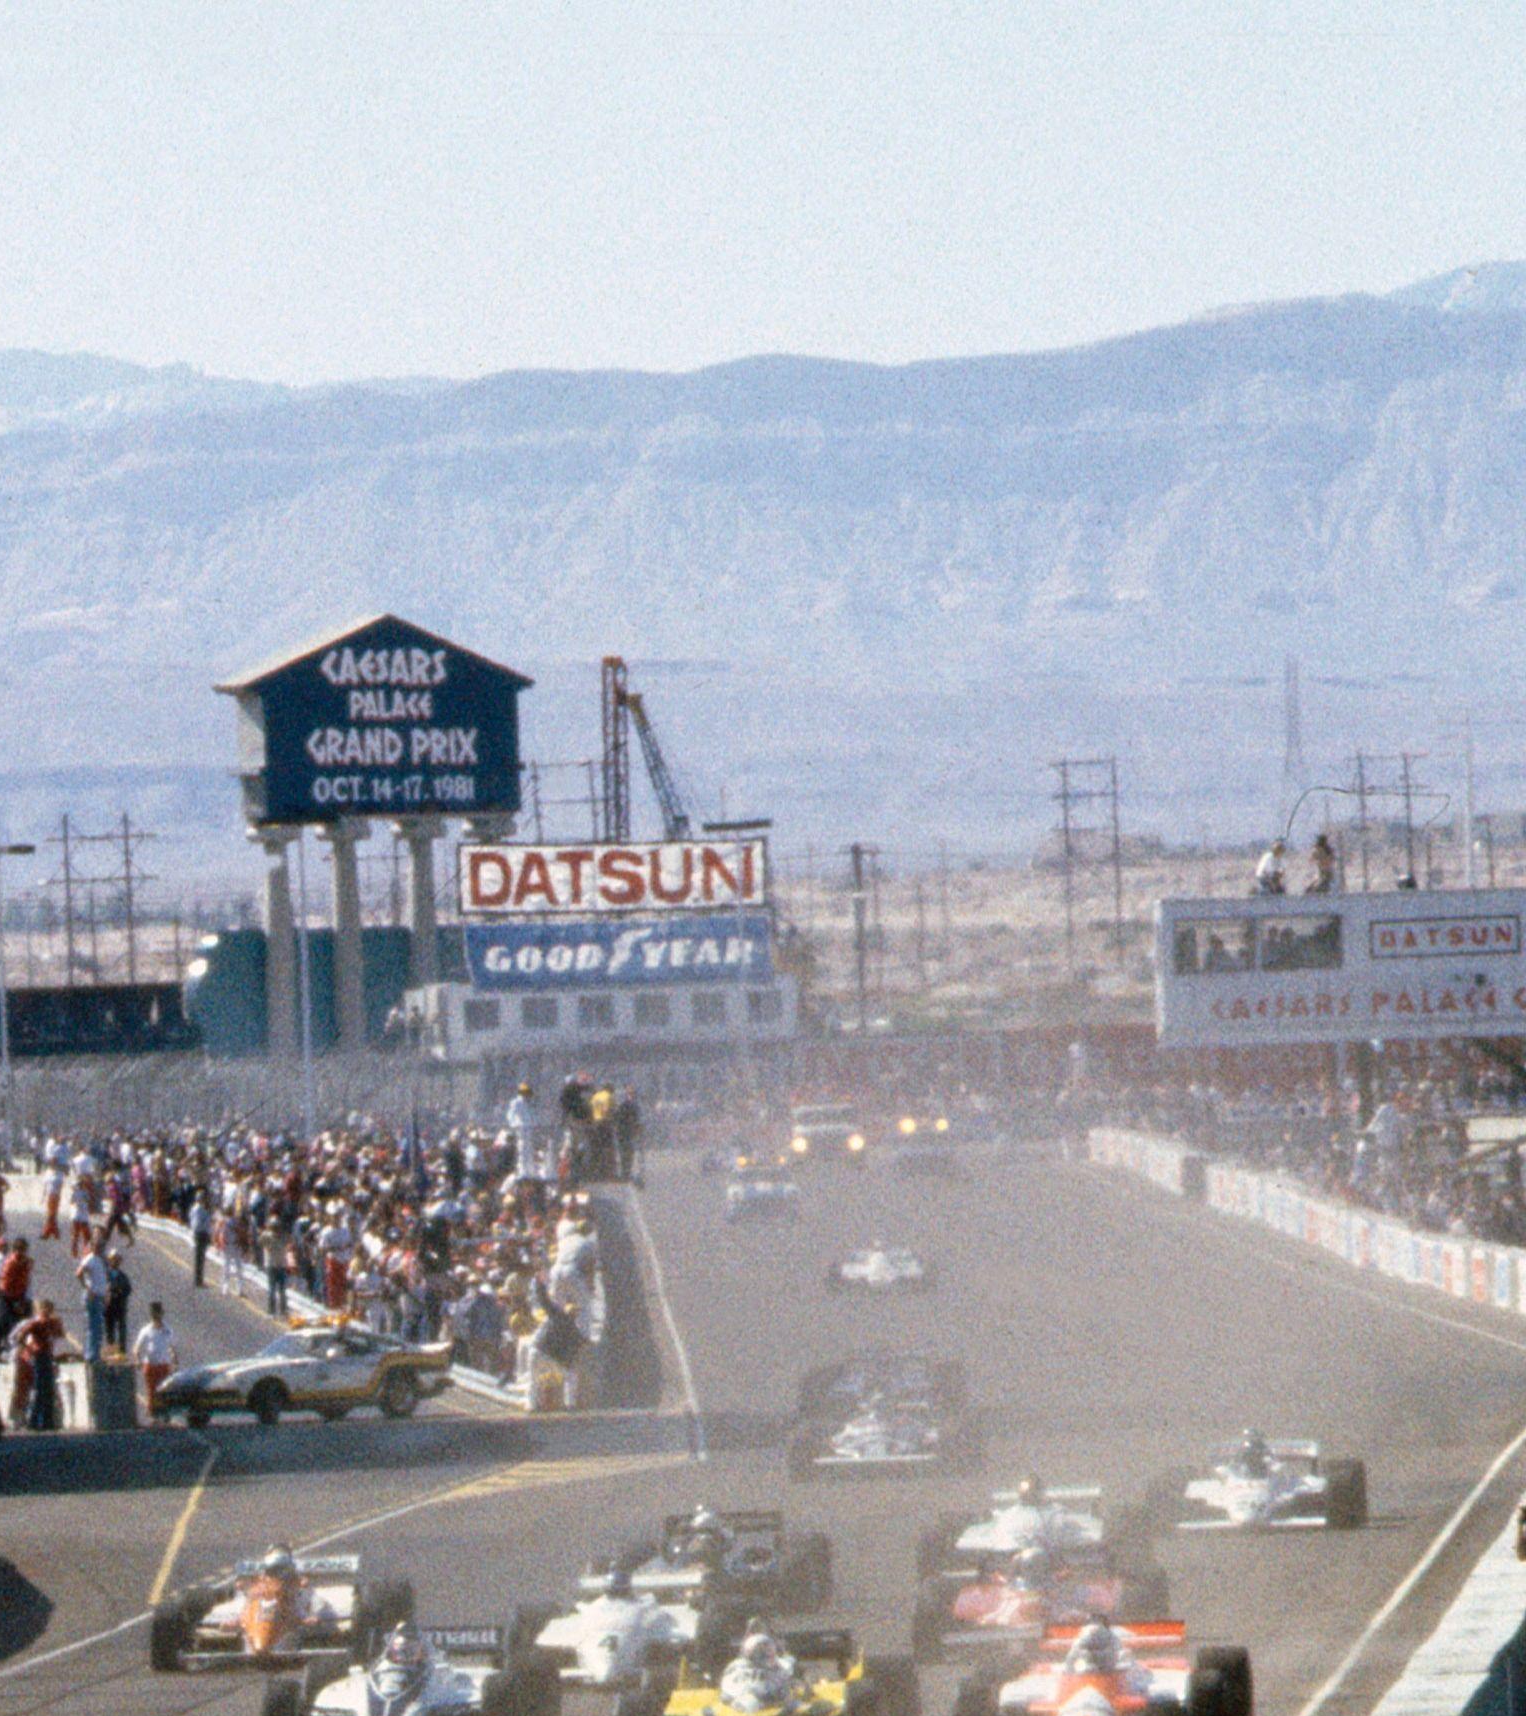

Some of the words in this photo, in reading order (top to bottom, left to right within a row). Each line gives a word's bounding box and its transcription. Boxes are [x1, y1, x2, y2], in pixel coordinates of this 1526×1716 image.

[319, 646, 447, 685] CAESARS
[349, 688, 432, 720] PALACE
[306, 727, 403, 766] GRAND
[411, 727, 479, 766] PRIX
[311, 775, 366, 802] OCT.
[433, 773, 476, 800] 1981
[468, 846, 754, 906] DATSUN
[1379, 923, 1513, 948] DATSUN
[1210, 992, 1350, 1019] CAESARS
